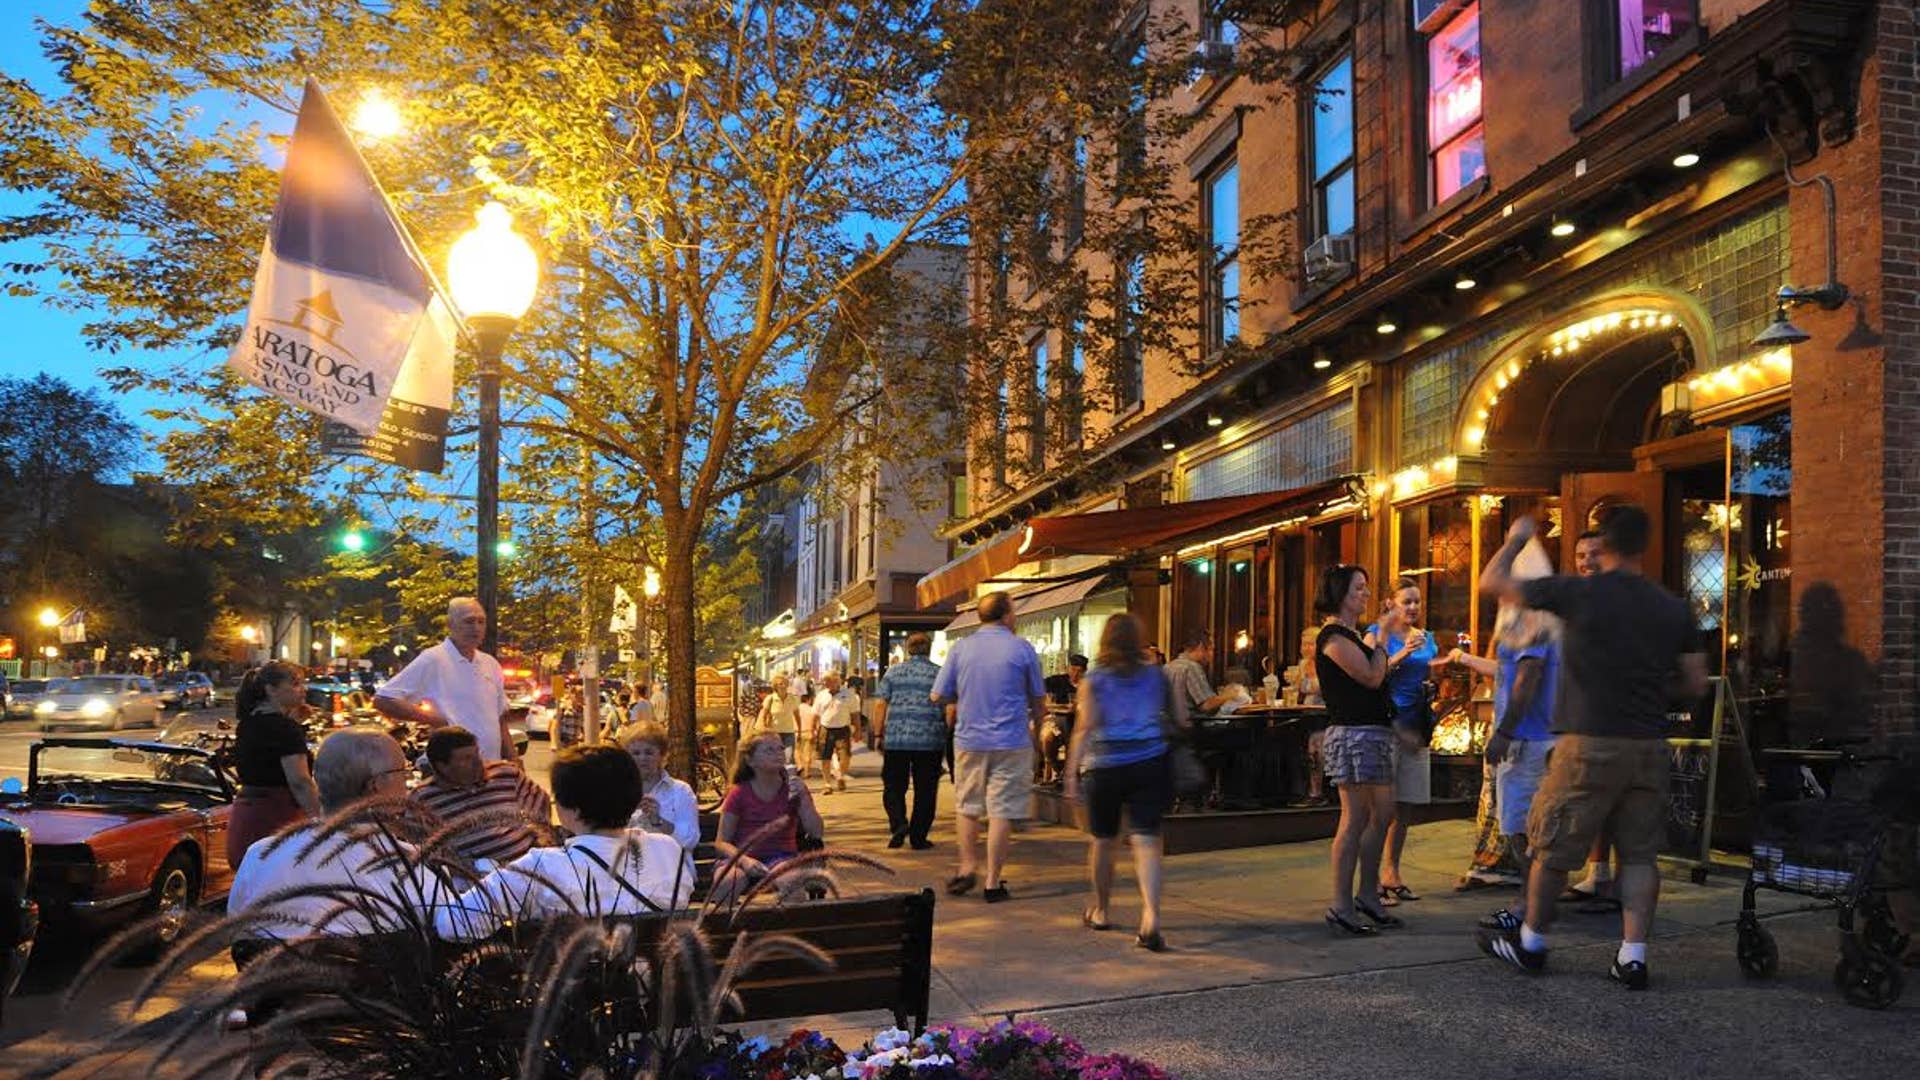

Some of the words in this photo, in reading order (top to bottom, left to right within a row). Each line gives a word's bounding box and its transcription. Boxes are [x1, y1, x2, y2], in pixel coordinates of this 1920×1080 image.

[252, 325, 378, 397] ARATOGA
[253, 352, 311, 386] ASINO
[315, 382, 361, 405] AND
[1755, 567, 1789, 582] CANTIN
